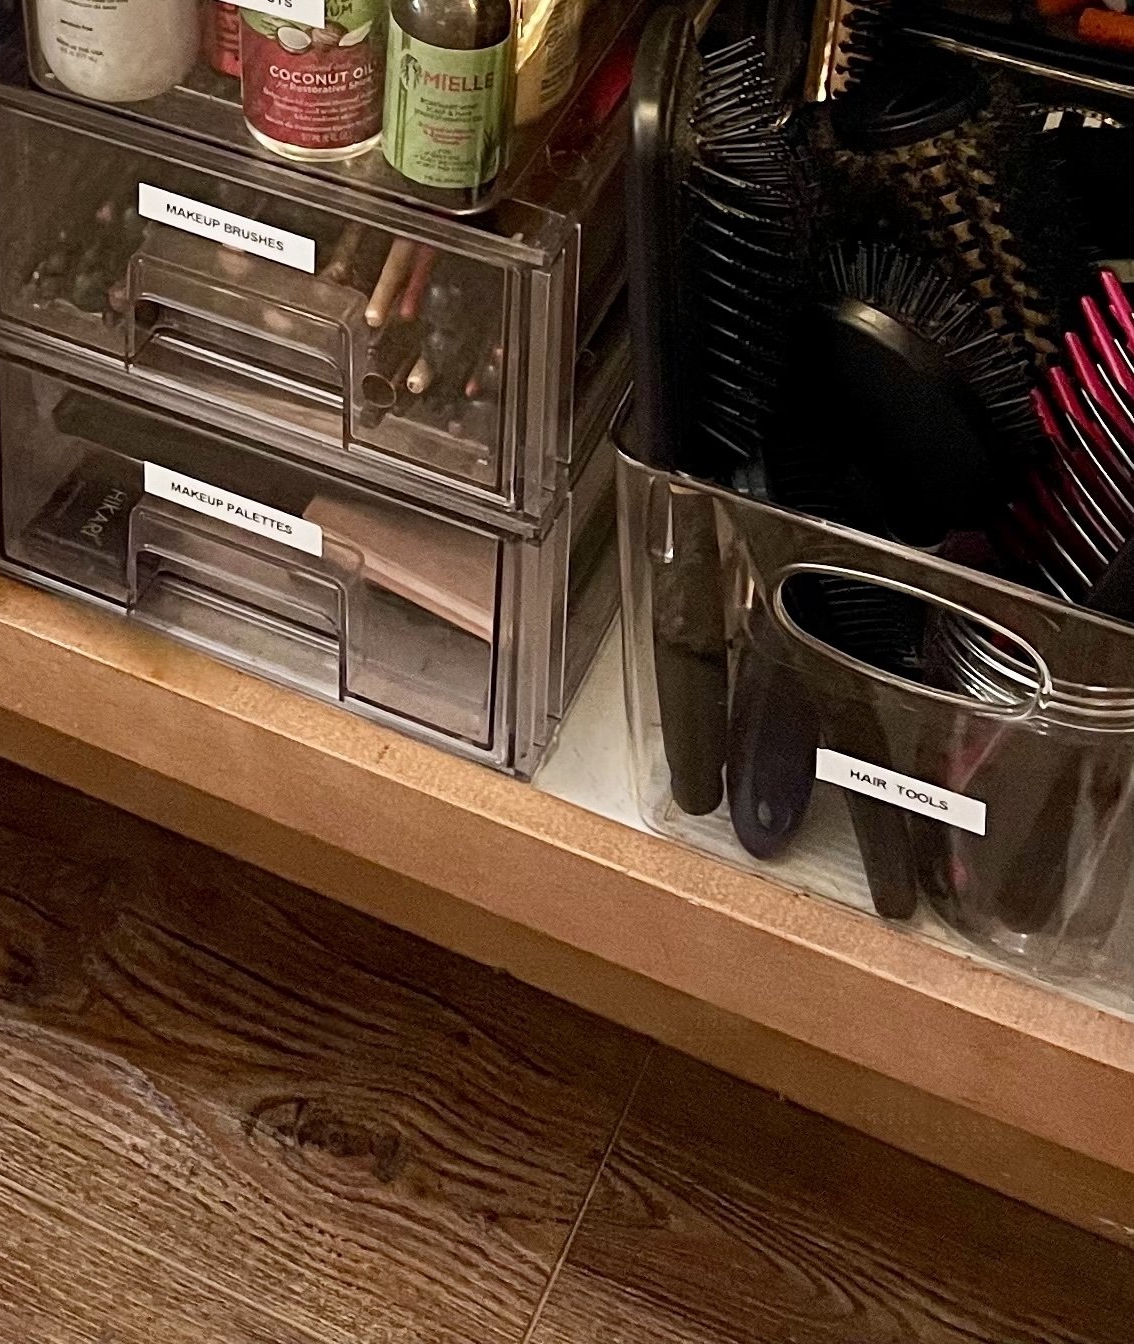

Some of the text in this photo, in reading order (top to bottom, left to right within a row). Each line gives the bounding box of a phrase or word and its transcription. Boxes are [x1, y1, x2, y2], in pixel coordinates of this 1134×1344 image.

[269, 65, 348, 85] COCONUT
[353, 64, 374, 79] OIL
[289, 81, 346, 93] Restorative
[424, 72, 494, 92] MIELLE
[166, 203, 284, 251] MAKEUP BRUSHES
[171, 482, 292, 535] MAKEUP PALETTES
[850, 769, 949, 811] HAIR TOOLS
